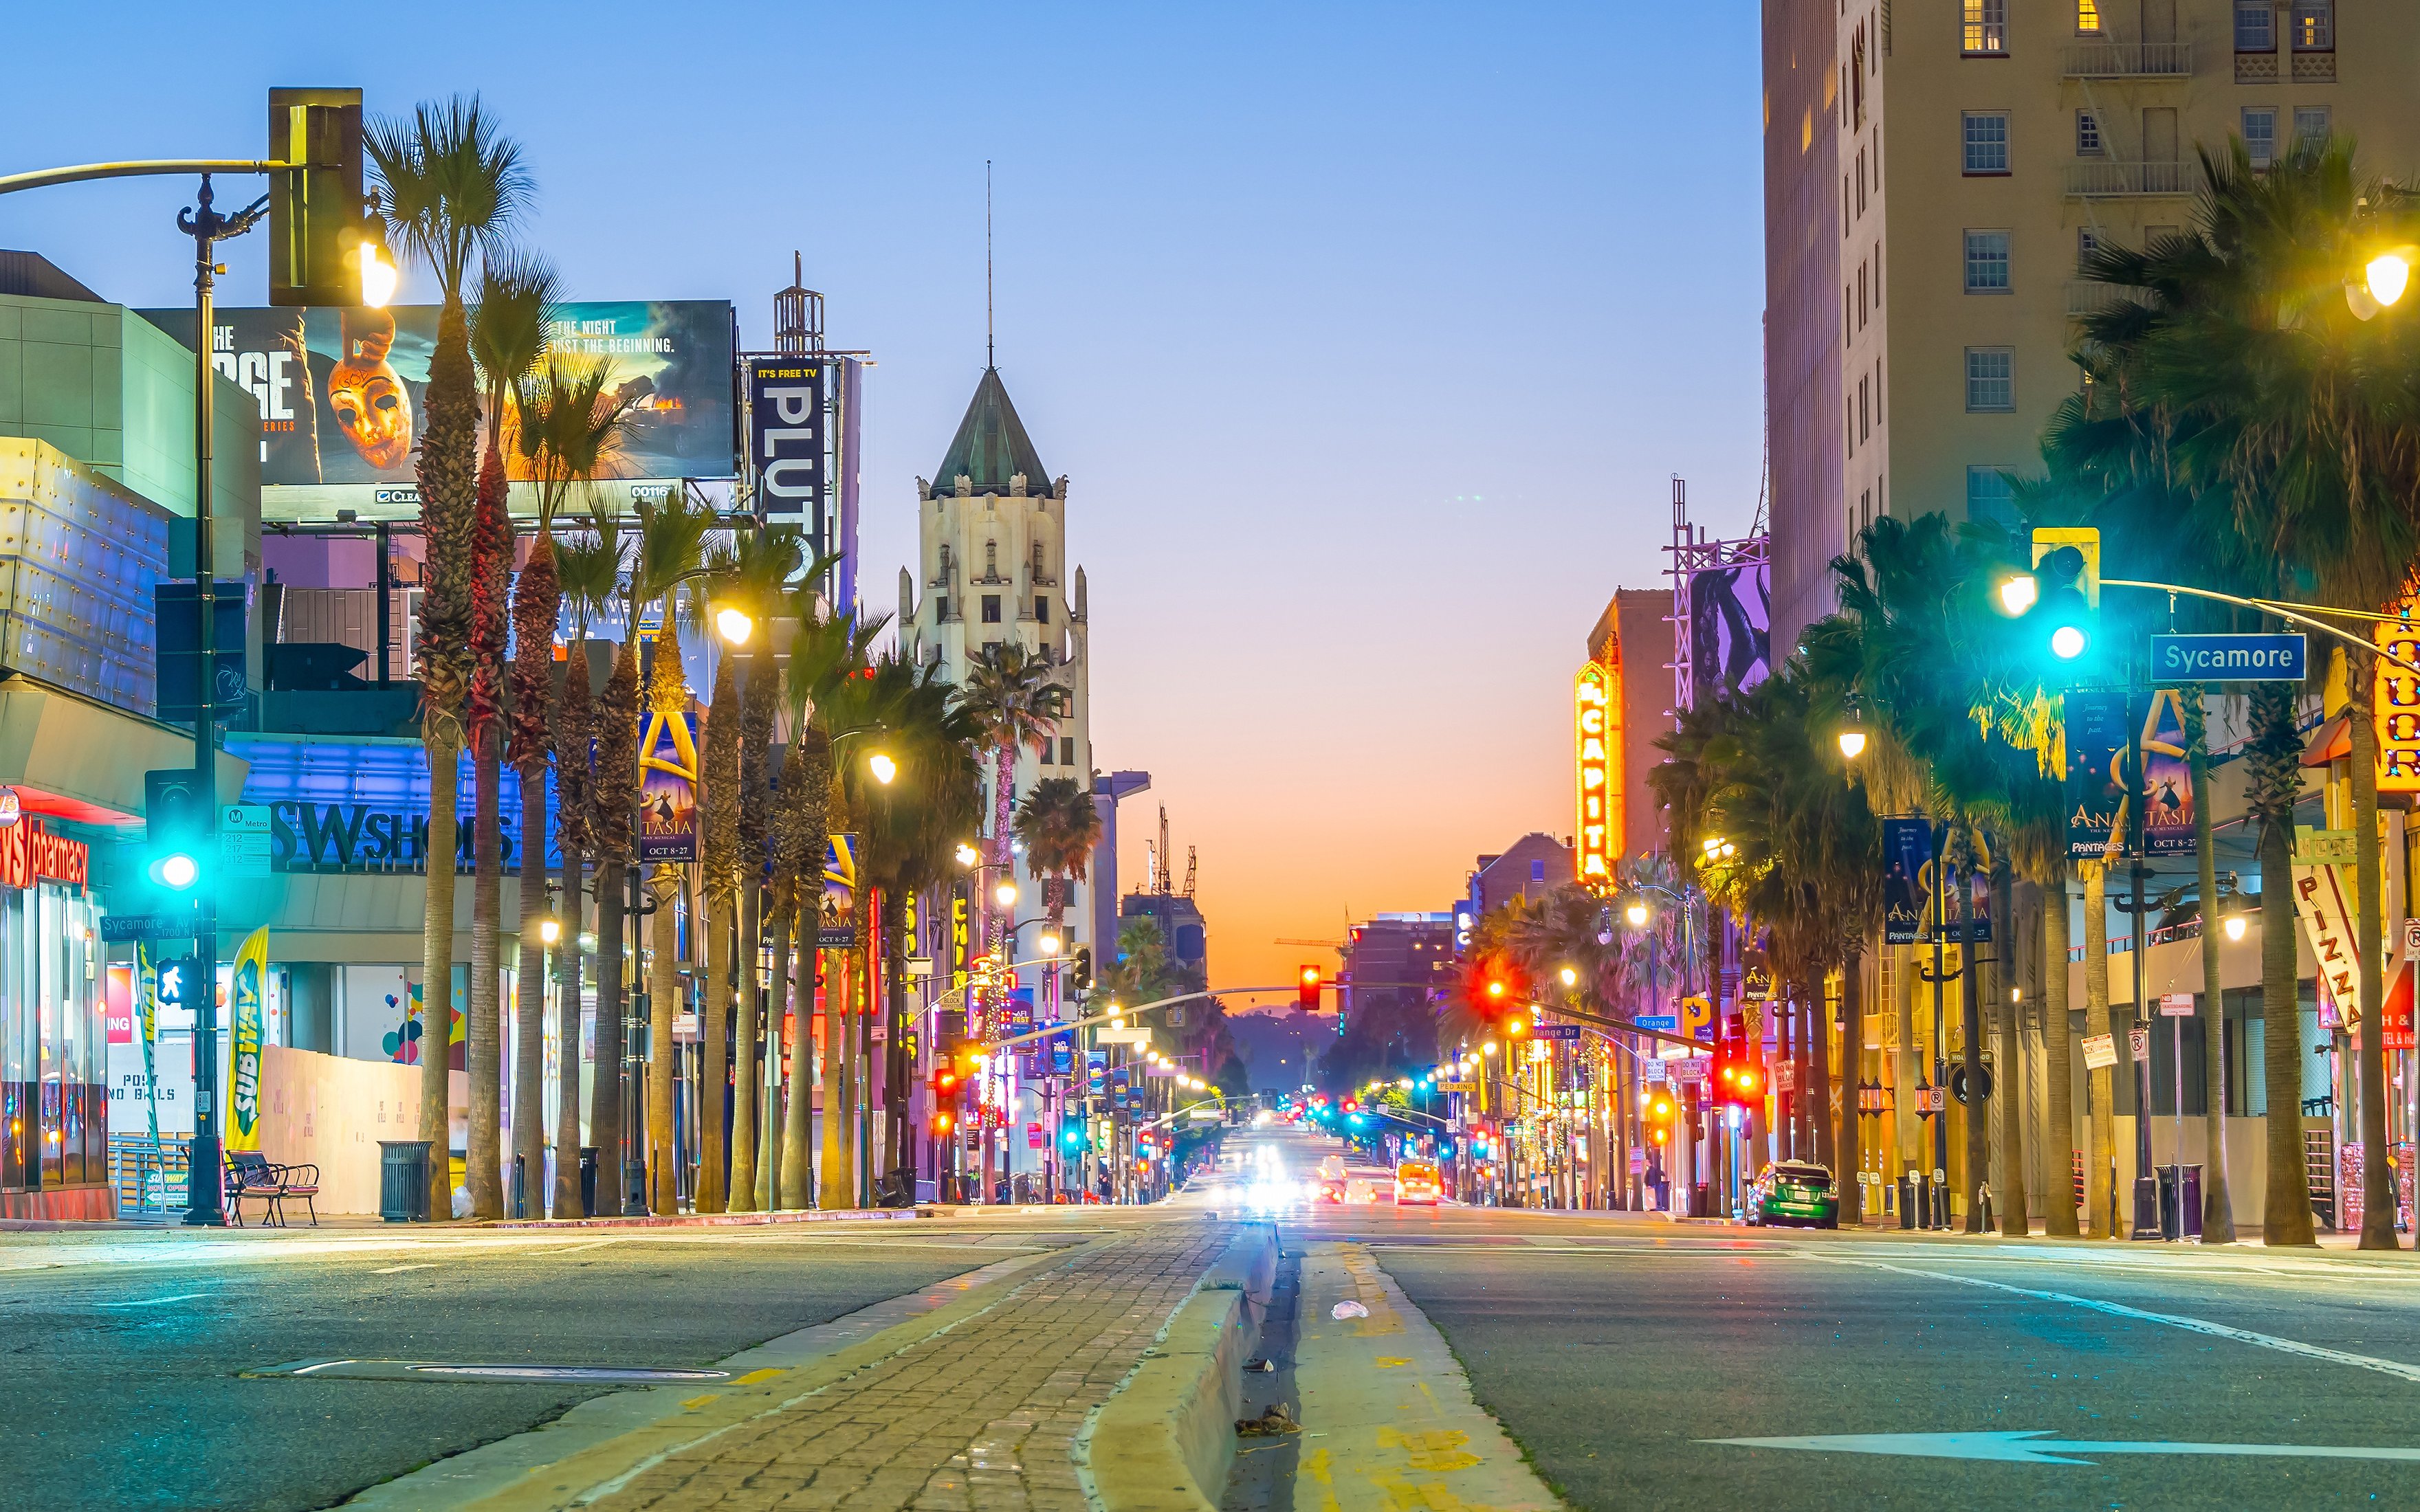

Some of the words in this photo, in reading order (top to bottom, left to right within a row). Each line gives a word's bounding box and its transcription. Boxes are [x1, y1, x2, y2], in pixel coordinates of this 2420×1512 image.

[582, 320, 615, 334] NIGHT
[212, 326, 234, 351] HE
[583, 340, 603, 353] THE
[609, 338, 674, 353] BEGINNING.
[339, 368, 368, 388] GOD
[758, 370, 776, 378] IT'S
[778, 370, 802, 378] FREE
[804, 369, 817, 377] TV
[263, 421, 295, 432] ERIES
[391, 491, 421, 502] CLEA
[2164, 645, 2293, 674] Sycamore
[2082, 703, 2107, 713] Journey
[1583, 709, 1607, 875] CAPITA
[239, 799, 372, 864] SW
[640, 820, 693, 835] TASIA
[226, 834, 242, 843] 212
[2154, 839, 2175, 848] OCT
[226, 845, 242, 854] 217
[649, 847, 668, 855] OCT
[2072, 842, 2124, 852] PANTAGES
[226, 856, 242, 864] 312
[104, 918, 163, 933] Sycamore
[821, 916, 852, 928] ASIA
[162, 929, 179, 937] 1700
[1889, 932, 1928, 940] PANTAGES
[2297, 876, 2361, 1027] PIZZA
[1642, 1019, 1669, 1027] Orange
[2398, 1014, 2409, 1025] &
[1529, 1029, 1561, 1038] Orange
[2383, 1032, 2394, 1045] TEL
[234, 972, 259, 1122] SUBWAY
[1778, 1074, 1793, 1082] BLOC
[135, 1089, 175, 1100] BILS
